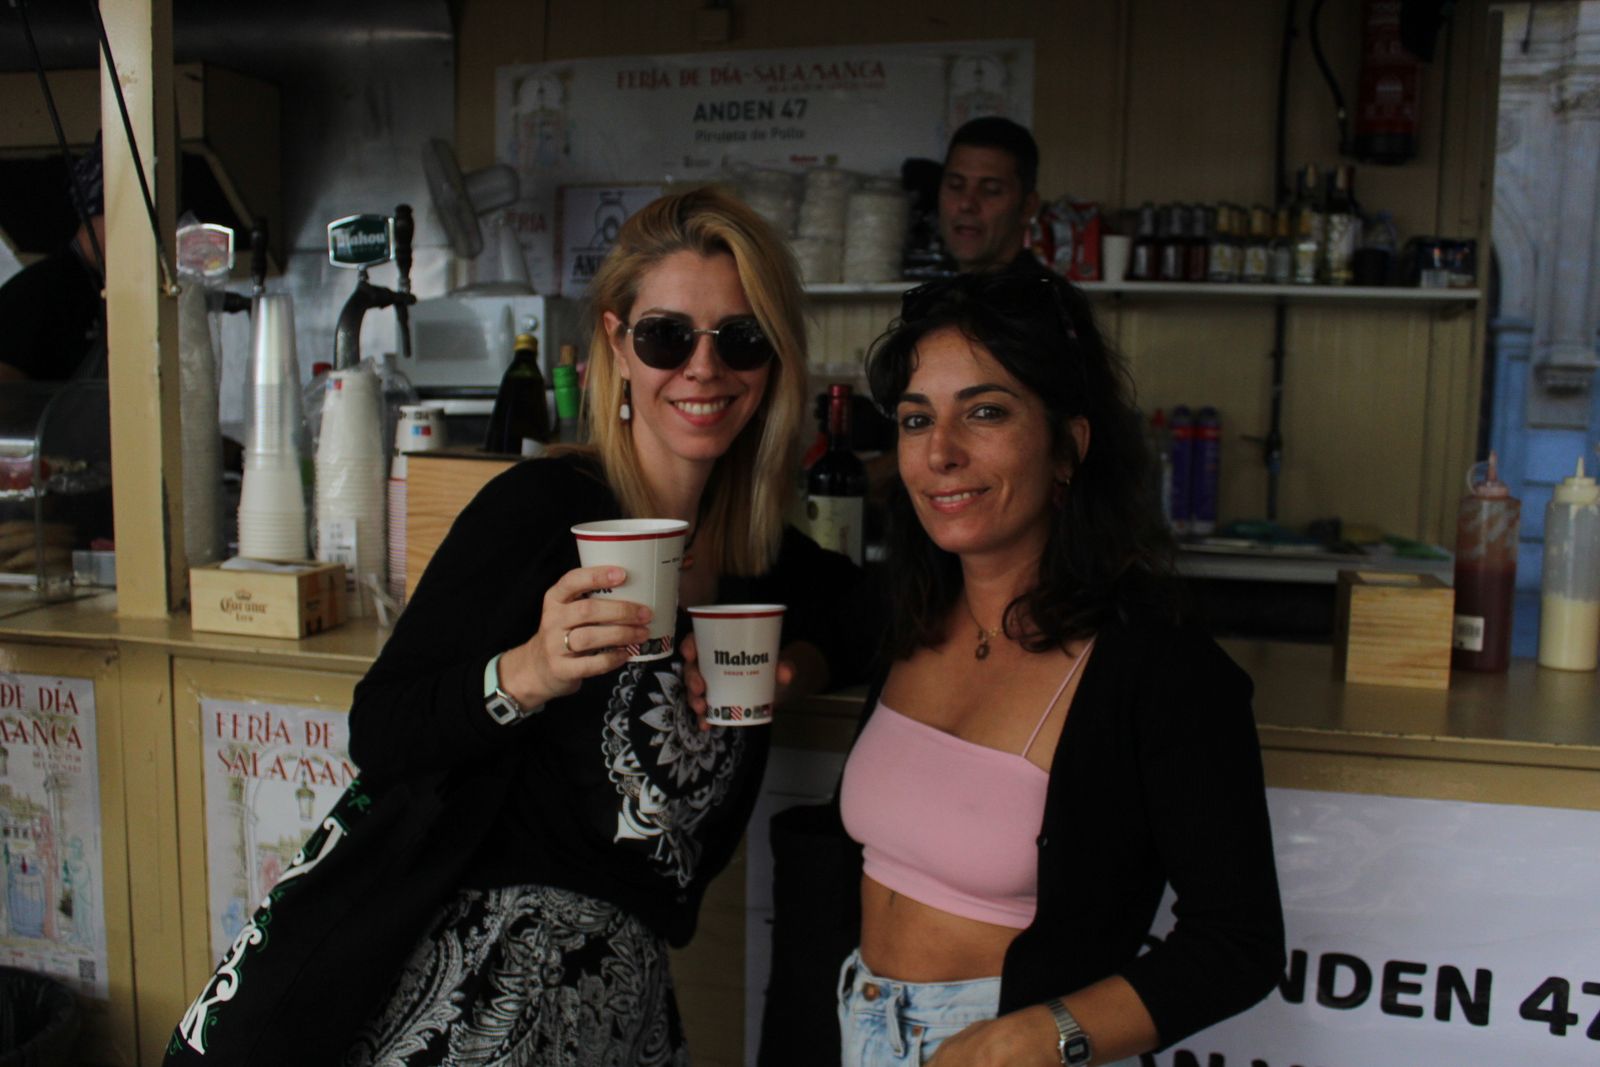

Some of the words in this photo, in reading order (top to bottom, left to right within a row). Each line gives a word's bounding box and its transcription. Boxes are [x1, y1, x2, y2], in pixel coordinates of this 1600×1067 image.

[679, 68, 700, 87] DE
[693, 100, 775, 122] ANDEN
[780, 98, 808, 120] 47
[750, 127, 767, 141] de
[771, 126, 806, 140] Pollo
[714, 650, 769, 666] Mahou
[0, 683, 24, 709] DE
[39, 680, 79, 715] DÍA
[305, 720, 335, 749] DE
[217, 750, 356, 787] SALAMAN
[1278, 949, 1493, 1026] NDEN
